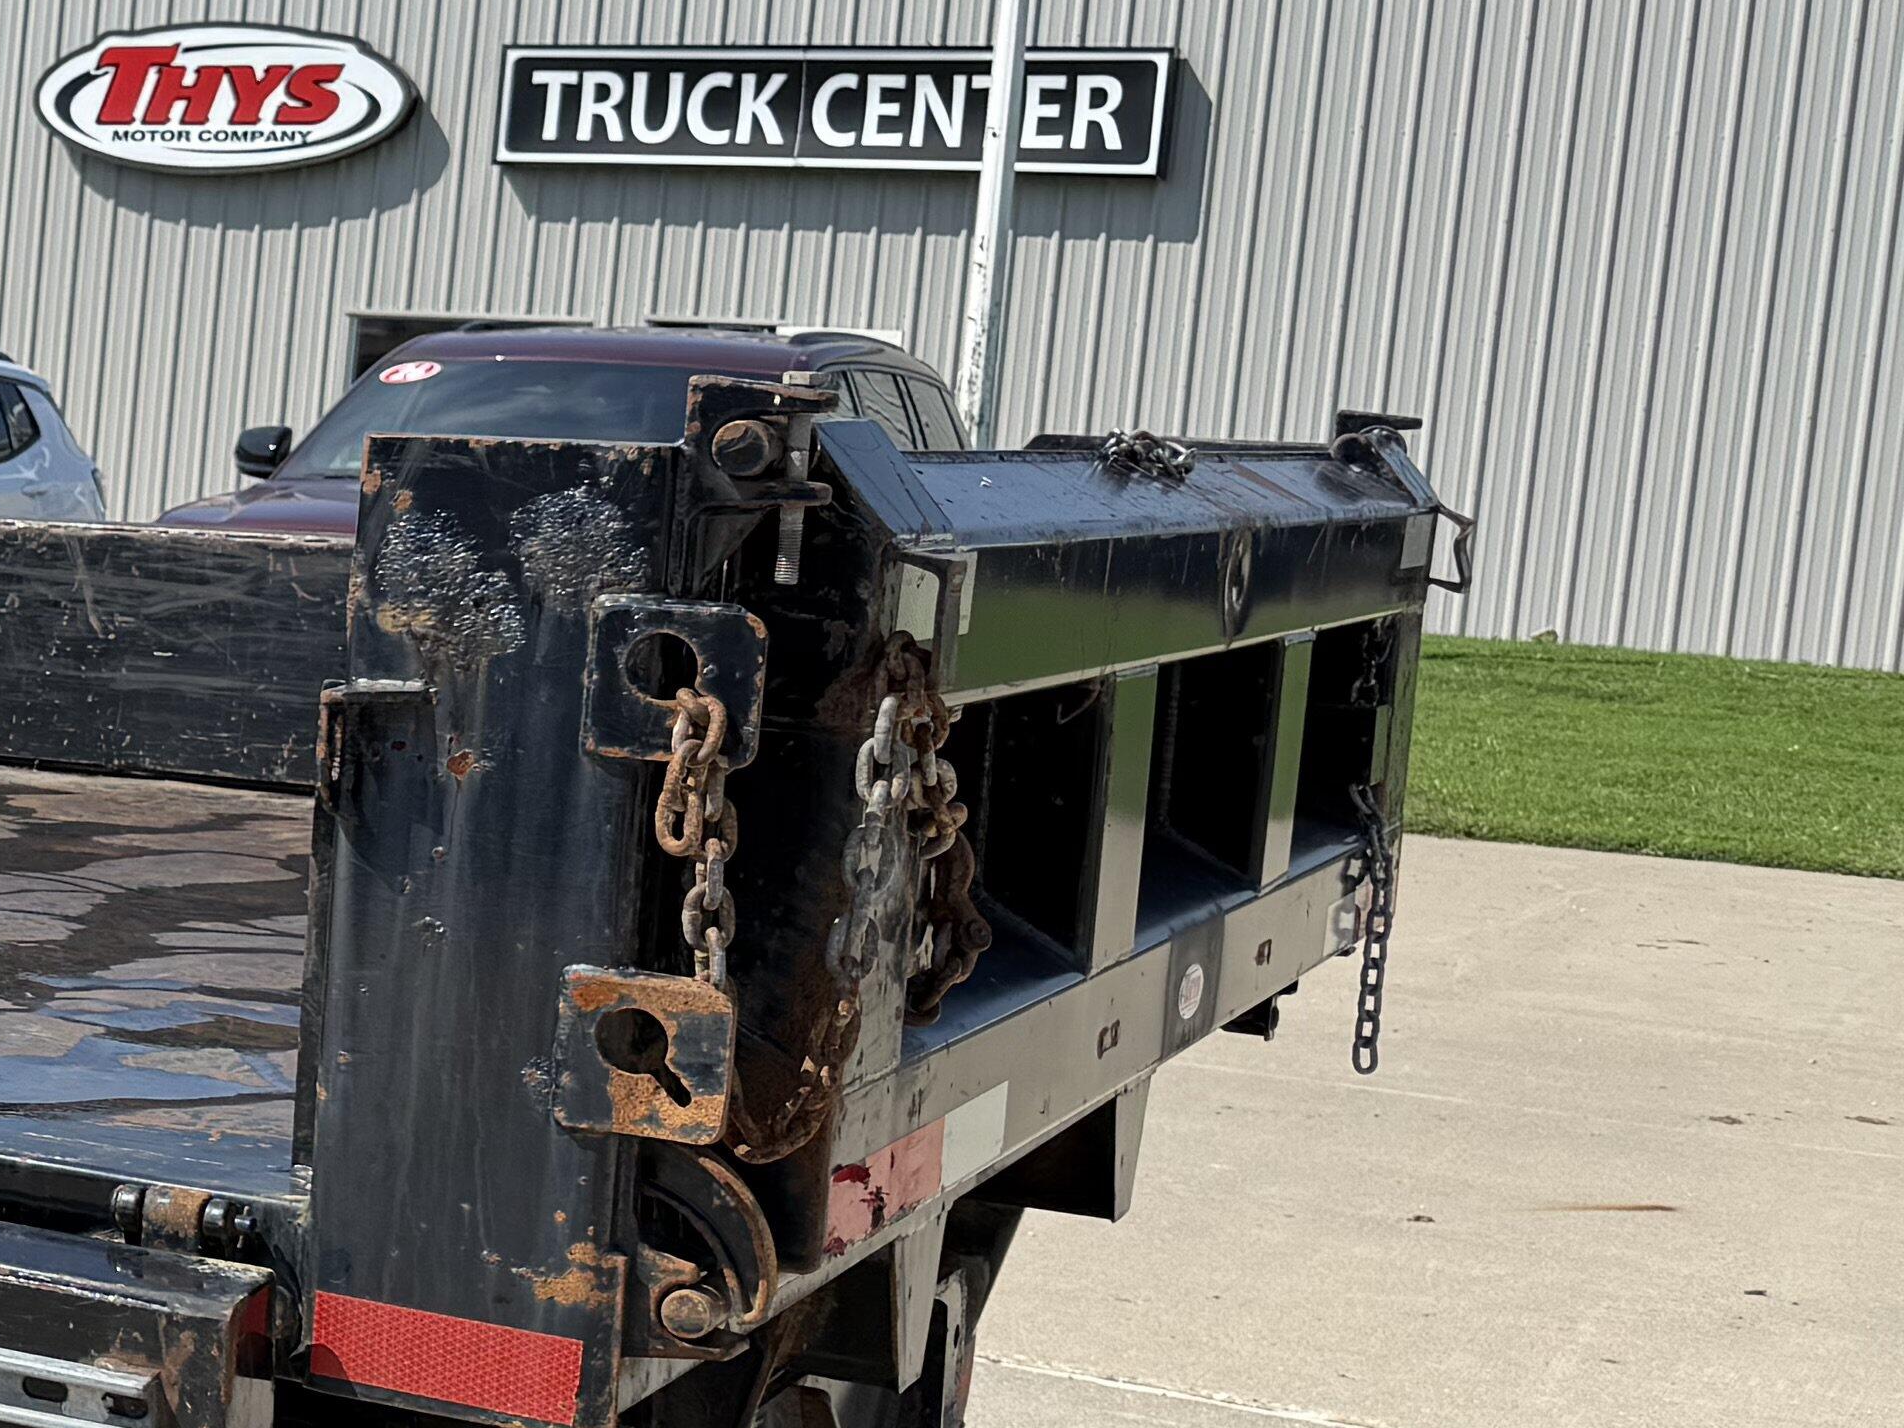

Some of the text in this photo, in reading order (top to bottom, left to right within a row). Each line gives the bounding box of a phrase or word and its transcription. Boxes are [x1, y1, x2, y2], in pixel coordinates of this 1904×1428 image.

[95, 42, 345, 125] THYS
[531, 71, 788, 146] TRUCK
[111, 129, 313, 145] MOTOR COMPANY
